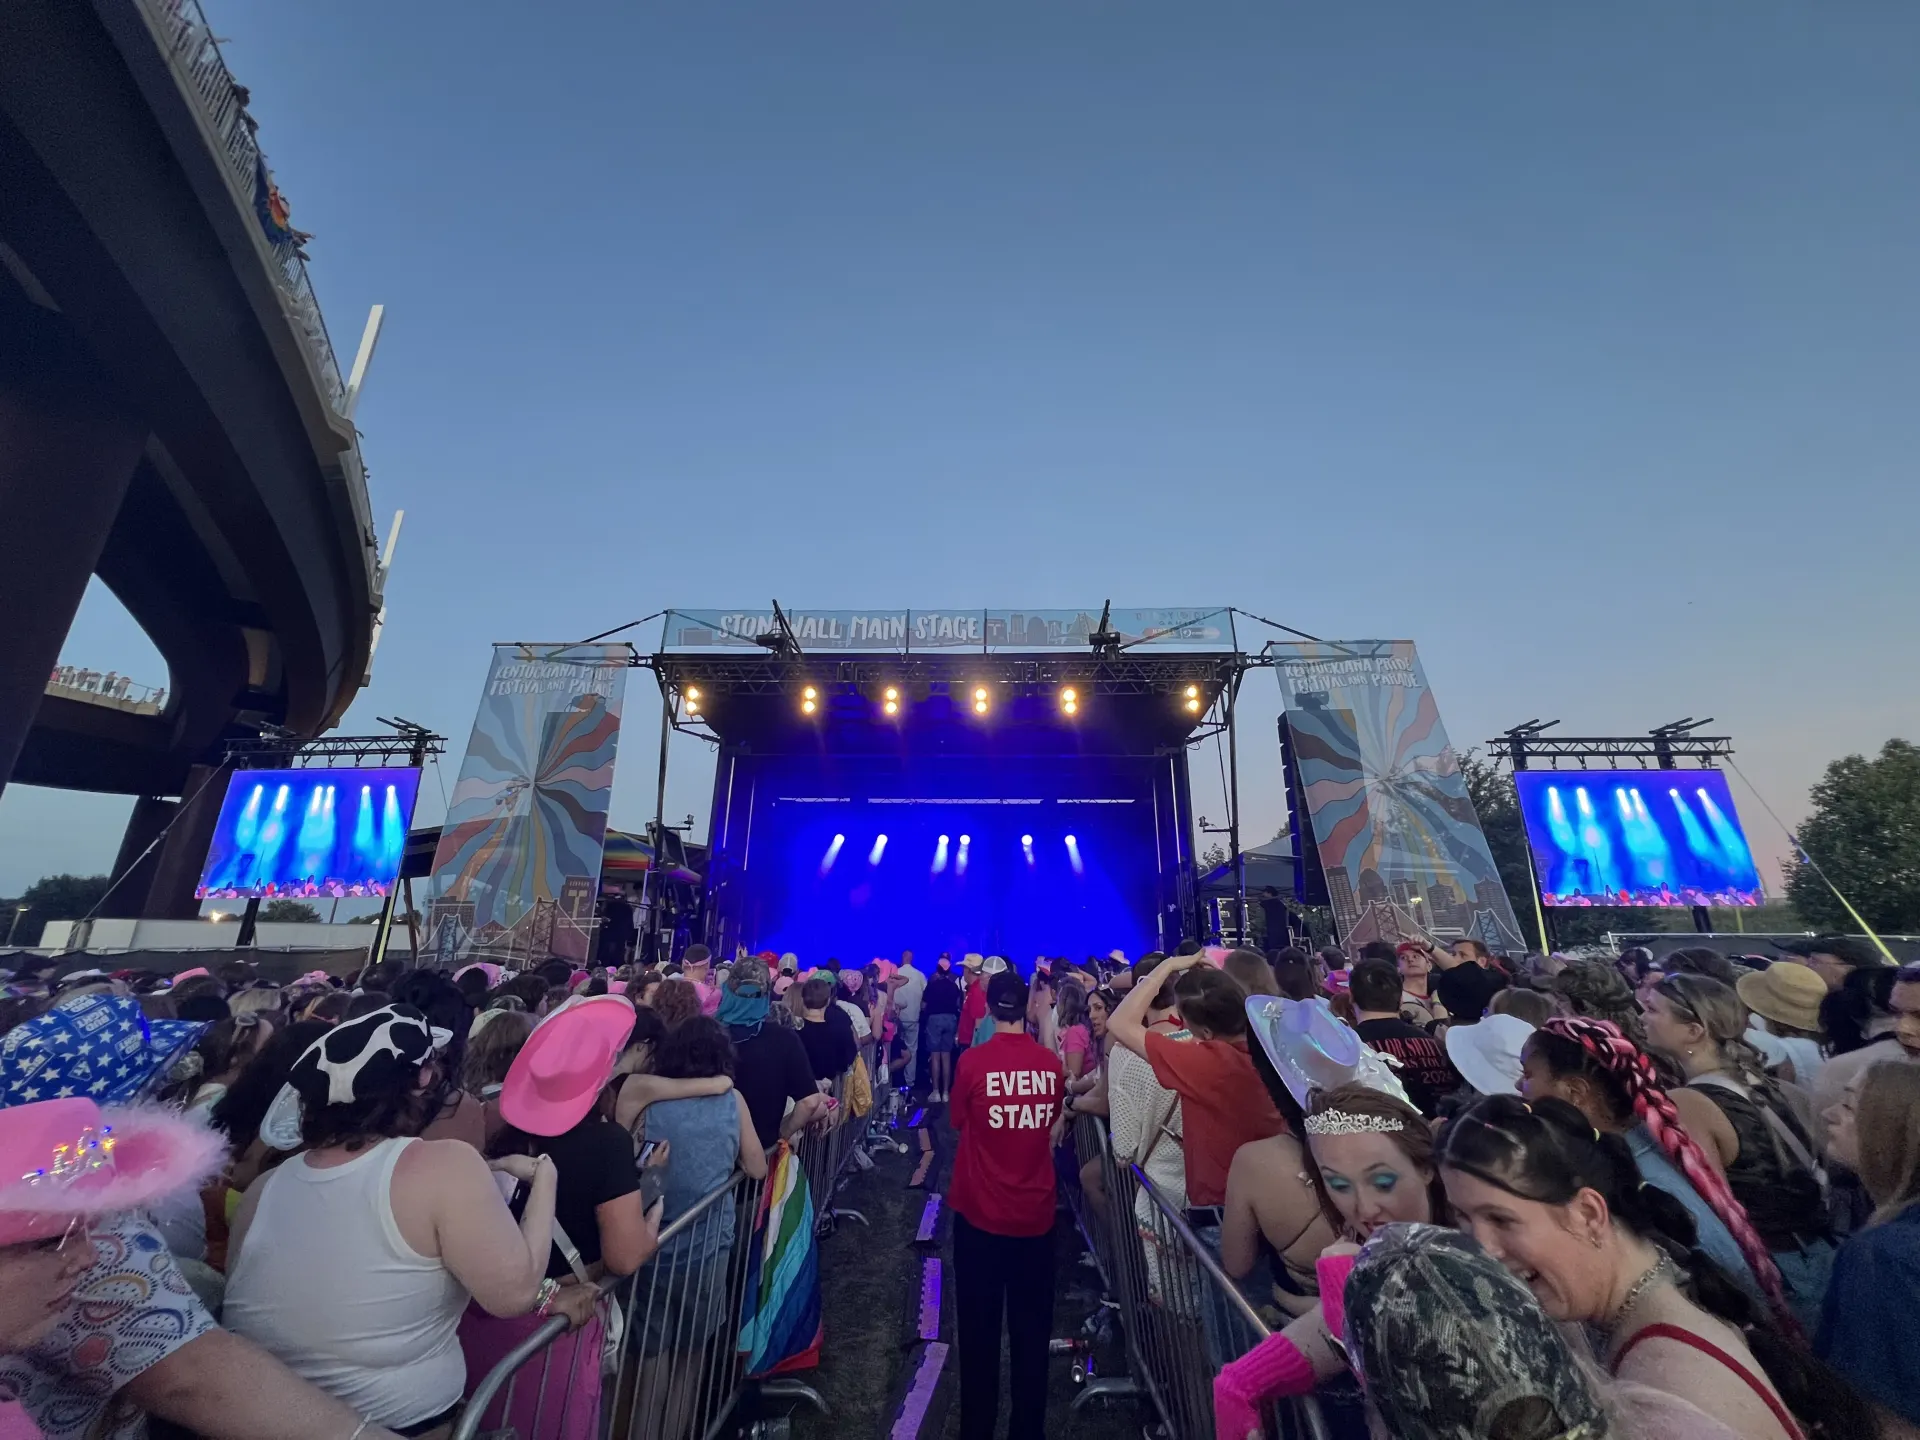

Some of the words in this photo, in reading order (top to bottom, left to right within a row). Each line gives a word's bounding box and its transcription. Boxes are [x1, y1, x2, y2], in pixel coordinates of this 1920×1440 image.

[718, 614, 842, 639] STONWALL
[915, 614, 979, 640] STAGE
[1375, 657, 1415, 672] PRIDE
[547, 680, 565, 691] AND
[1348, 675, 1368, 686] AND
[1371, 673, 1422, 688] PARADE
[1405, 1038, 1443, 1057] SWIFT
[986, 1070, 1057, 1097] EVENT
[988, 1102, 1055, 1129] STAFF
